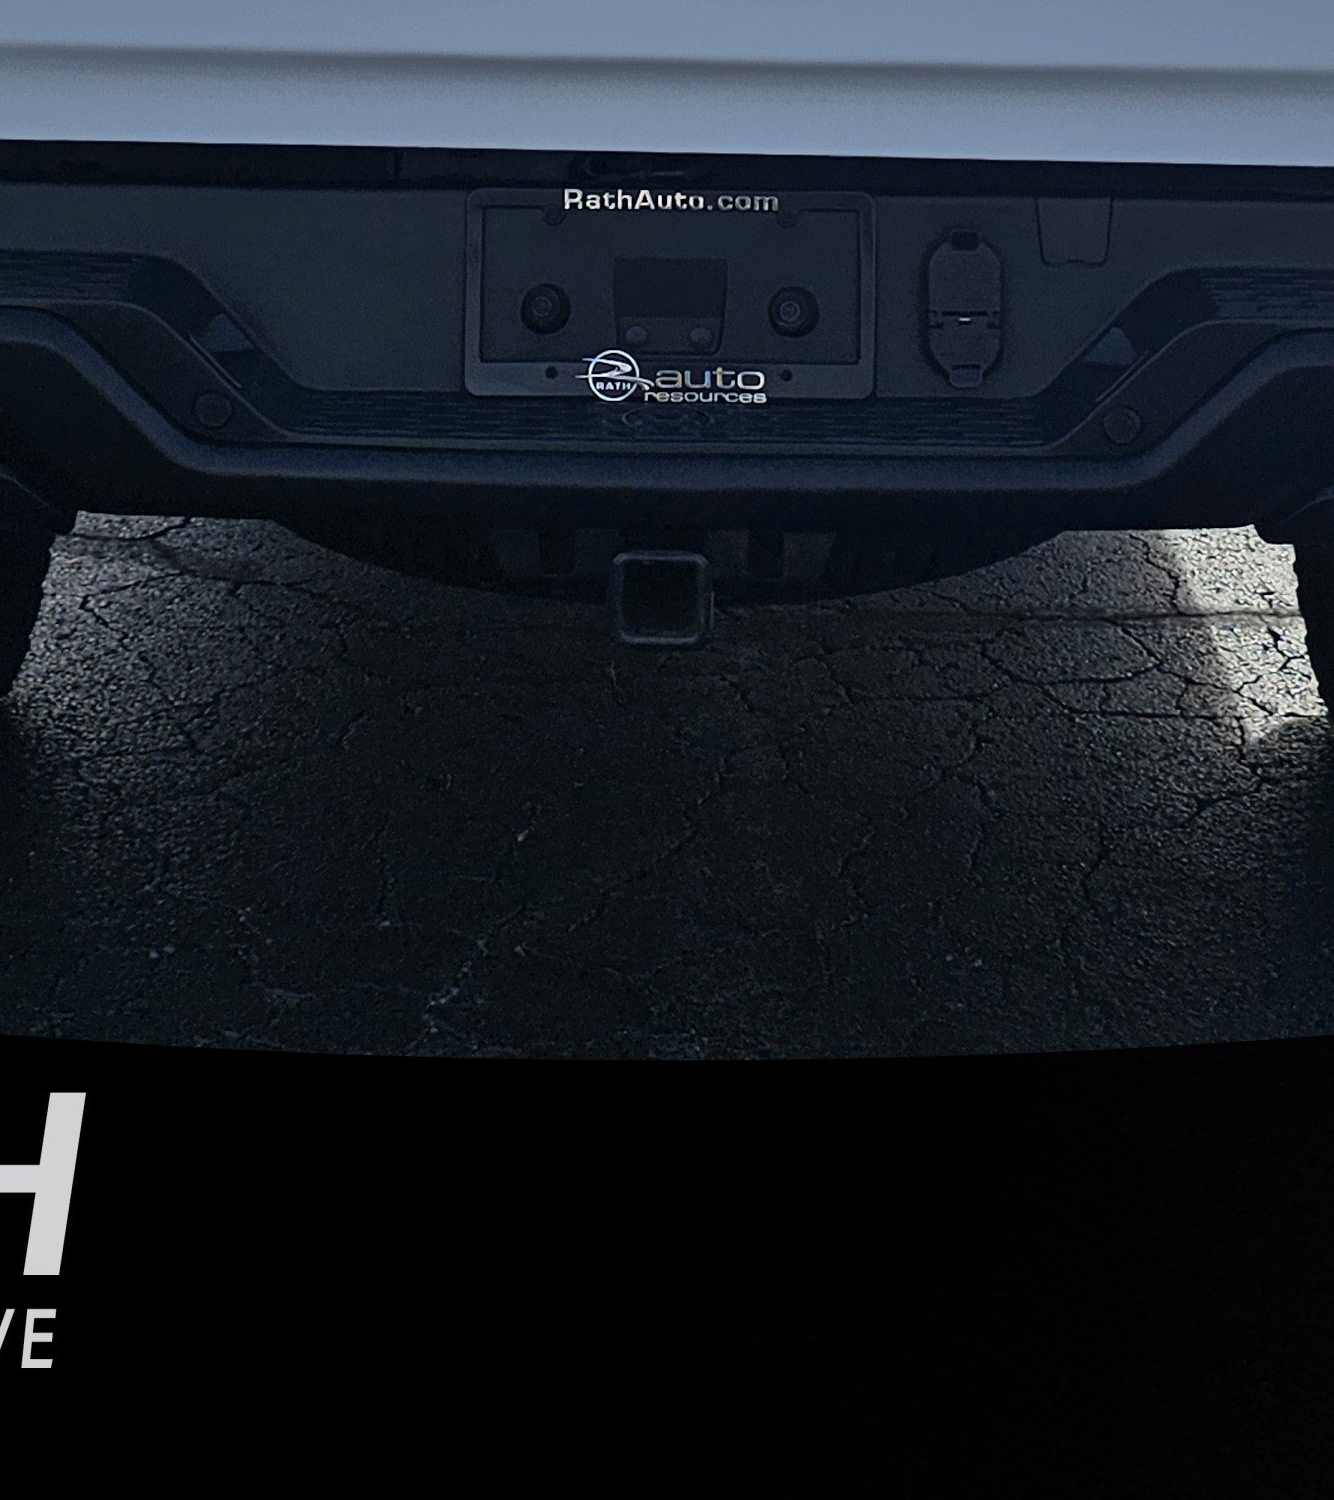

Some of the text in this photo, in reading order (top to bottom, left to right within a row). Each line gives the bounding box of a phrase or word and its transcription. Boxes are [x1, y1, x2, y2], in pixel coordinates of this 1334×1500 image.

[563, 188, 780, 211] RathAuto.com
[595, 380, 632, 391] RATH
[654, 367, 766, 390] auto
[643, 391, 767, 404] resources
